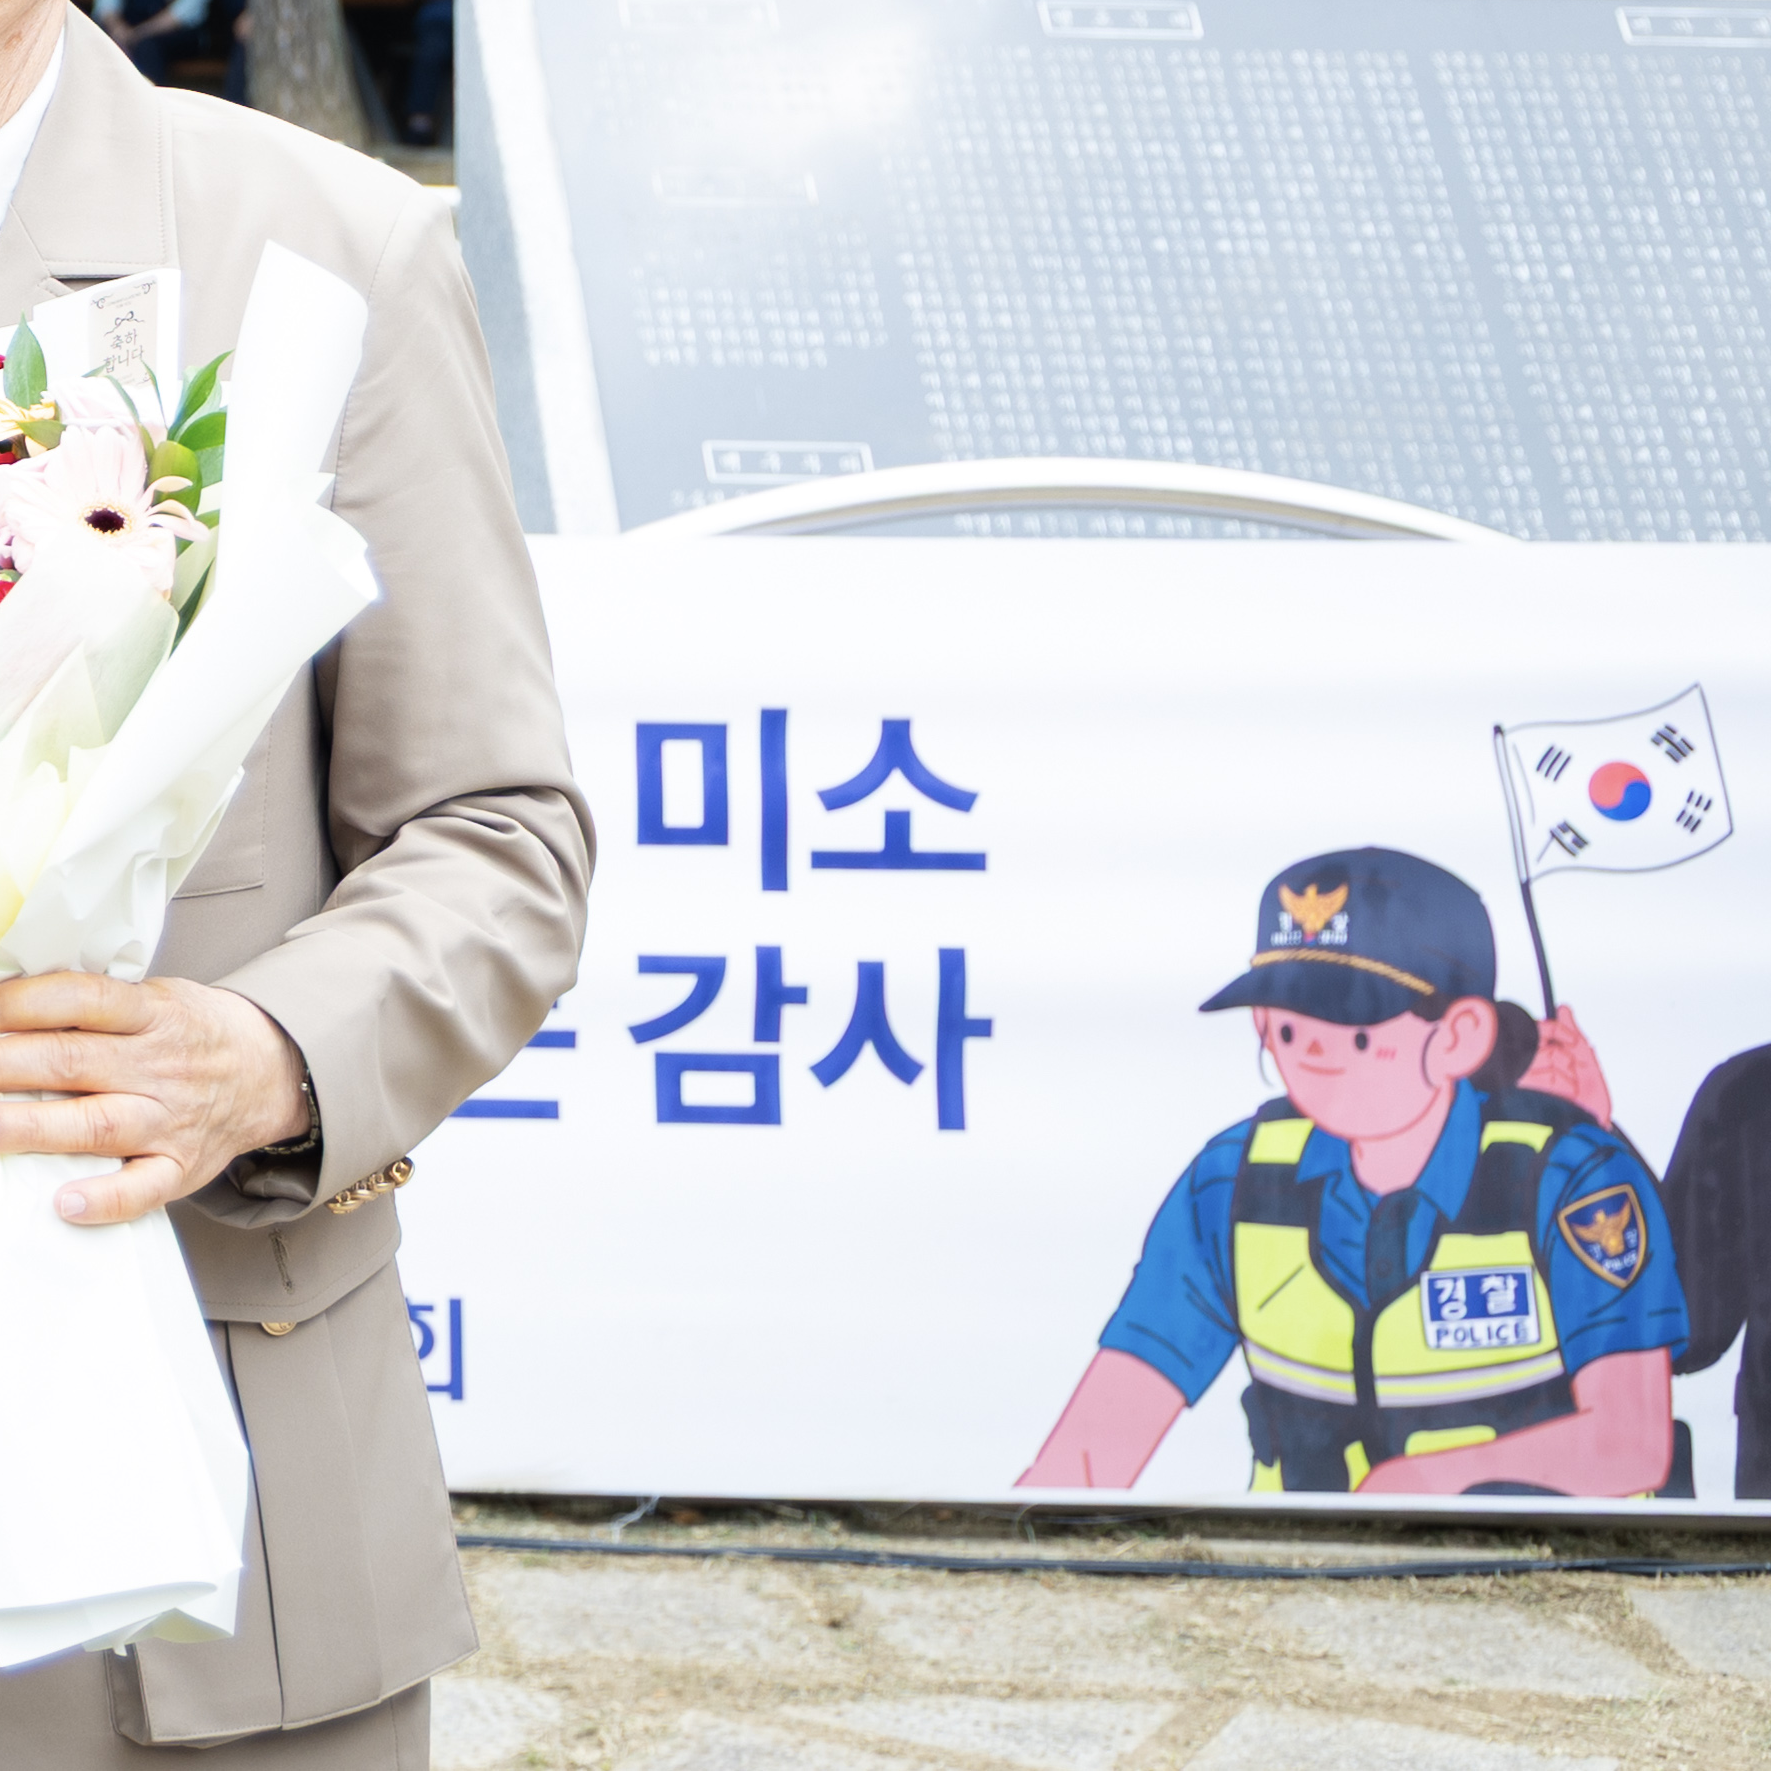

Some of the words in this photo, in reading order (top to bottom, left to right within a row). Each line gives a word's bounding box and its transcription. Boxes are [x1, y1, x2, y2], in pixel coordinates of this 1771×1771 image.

[111, 329, 137, 349] 축하
[103, 345, 144, 373] 합니다
[636, 708, 987, 892] 미소
[627, 945, 995, 1132] 감사
[1434, 1275, 1519, 1321] 경찰
[1435, 1321, 1528, 1349] POLICE
